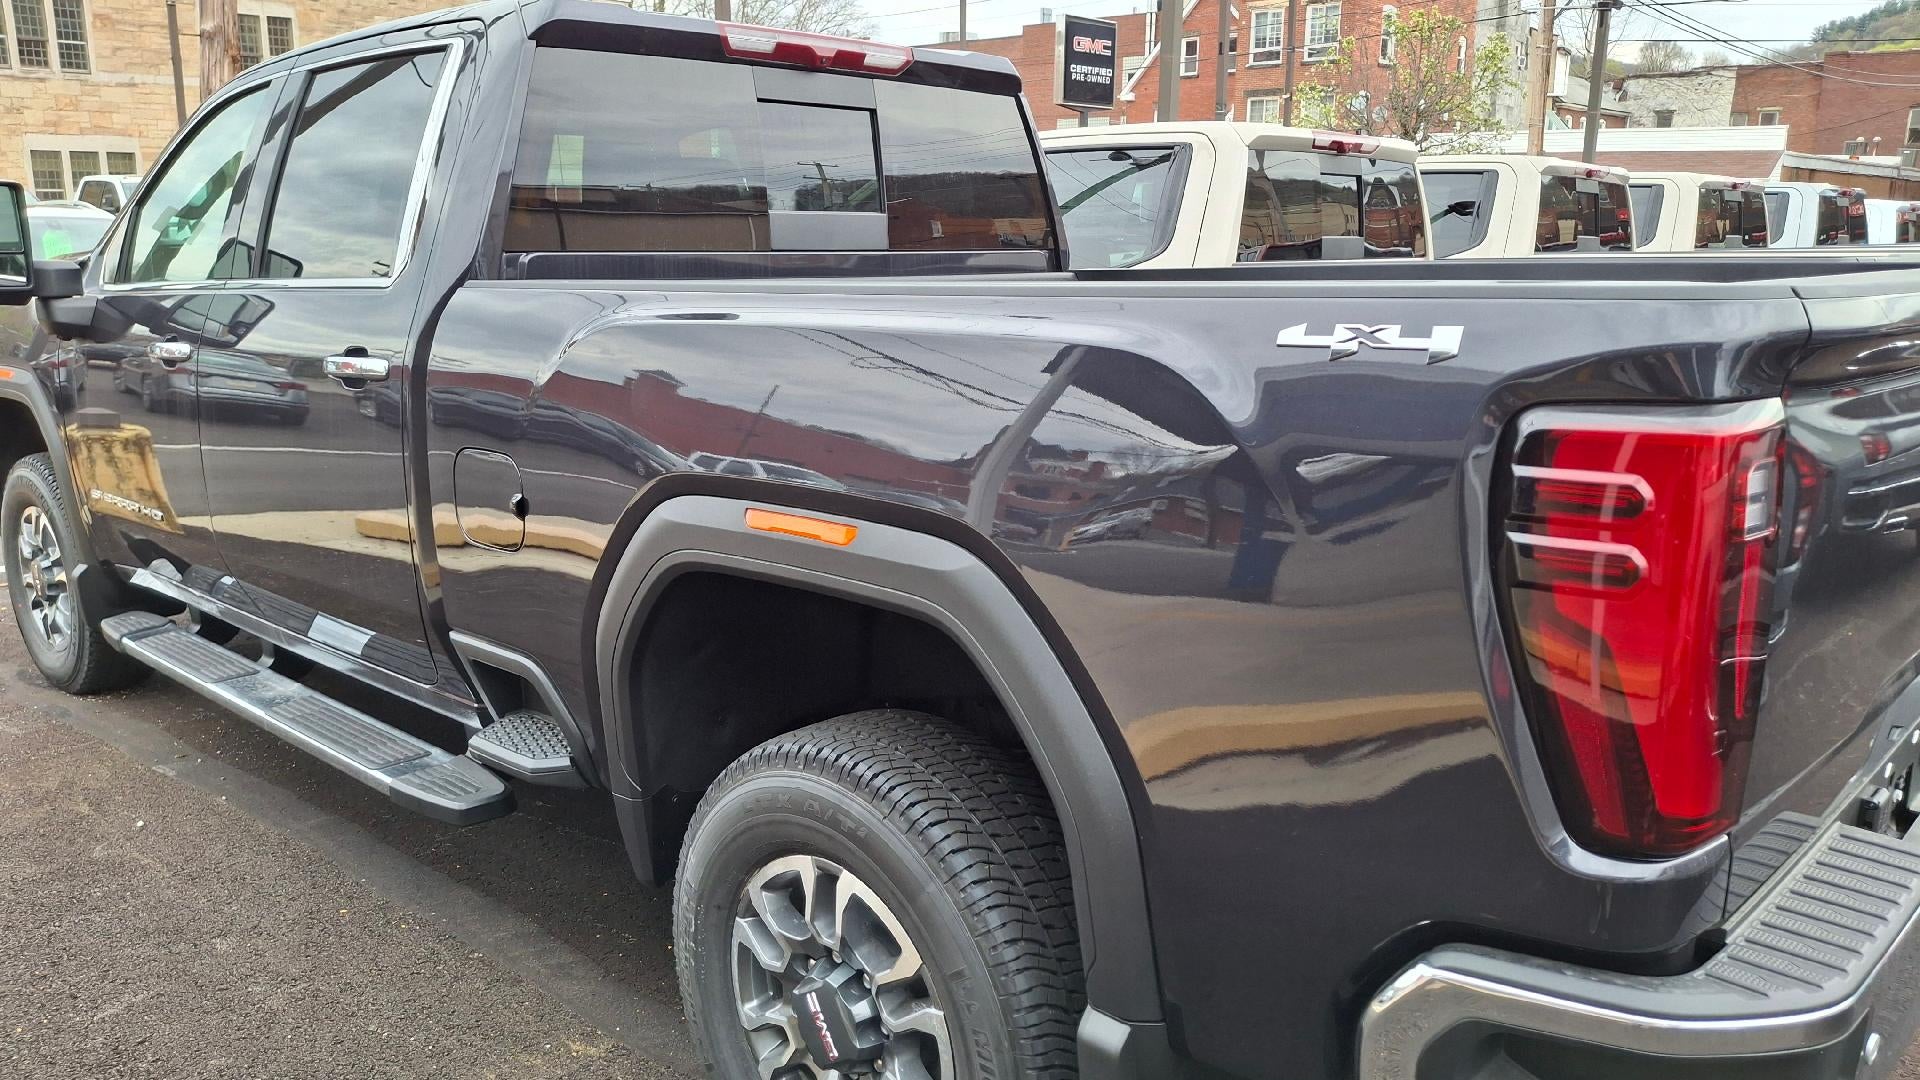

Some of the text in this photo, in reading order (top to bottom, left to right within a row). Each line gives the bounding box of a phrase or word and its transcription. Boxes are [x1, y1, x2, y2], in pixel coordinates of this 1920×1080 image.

[1073, 36, 1112, 56] GMC
[1070, 64, 1113, 76] CERTIFIED
[1071, 72, 1111, 84] PRE-OWNED
